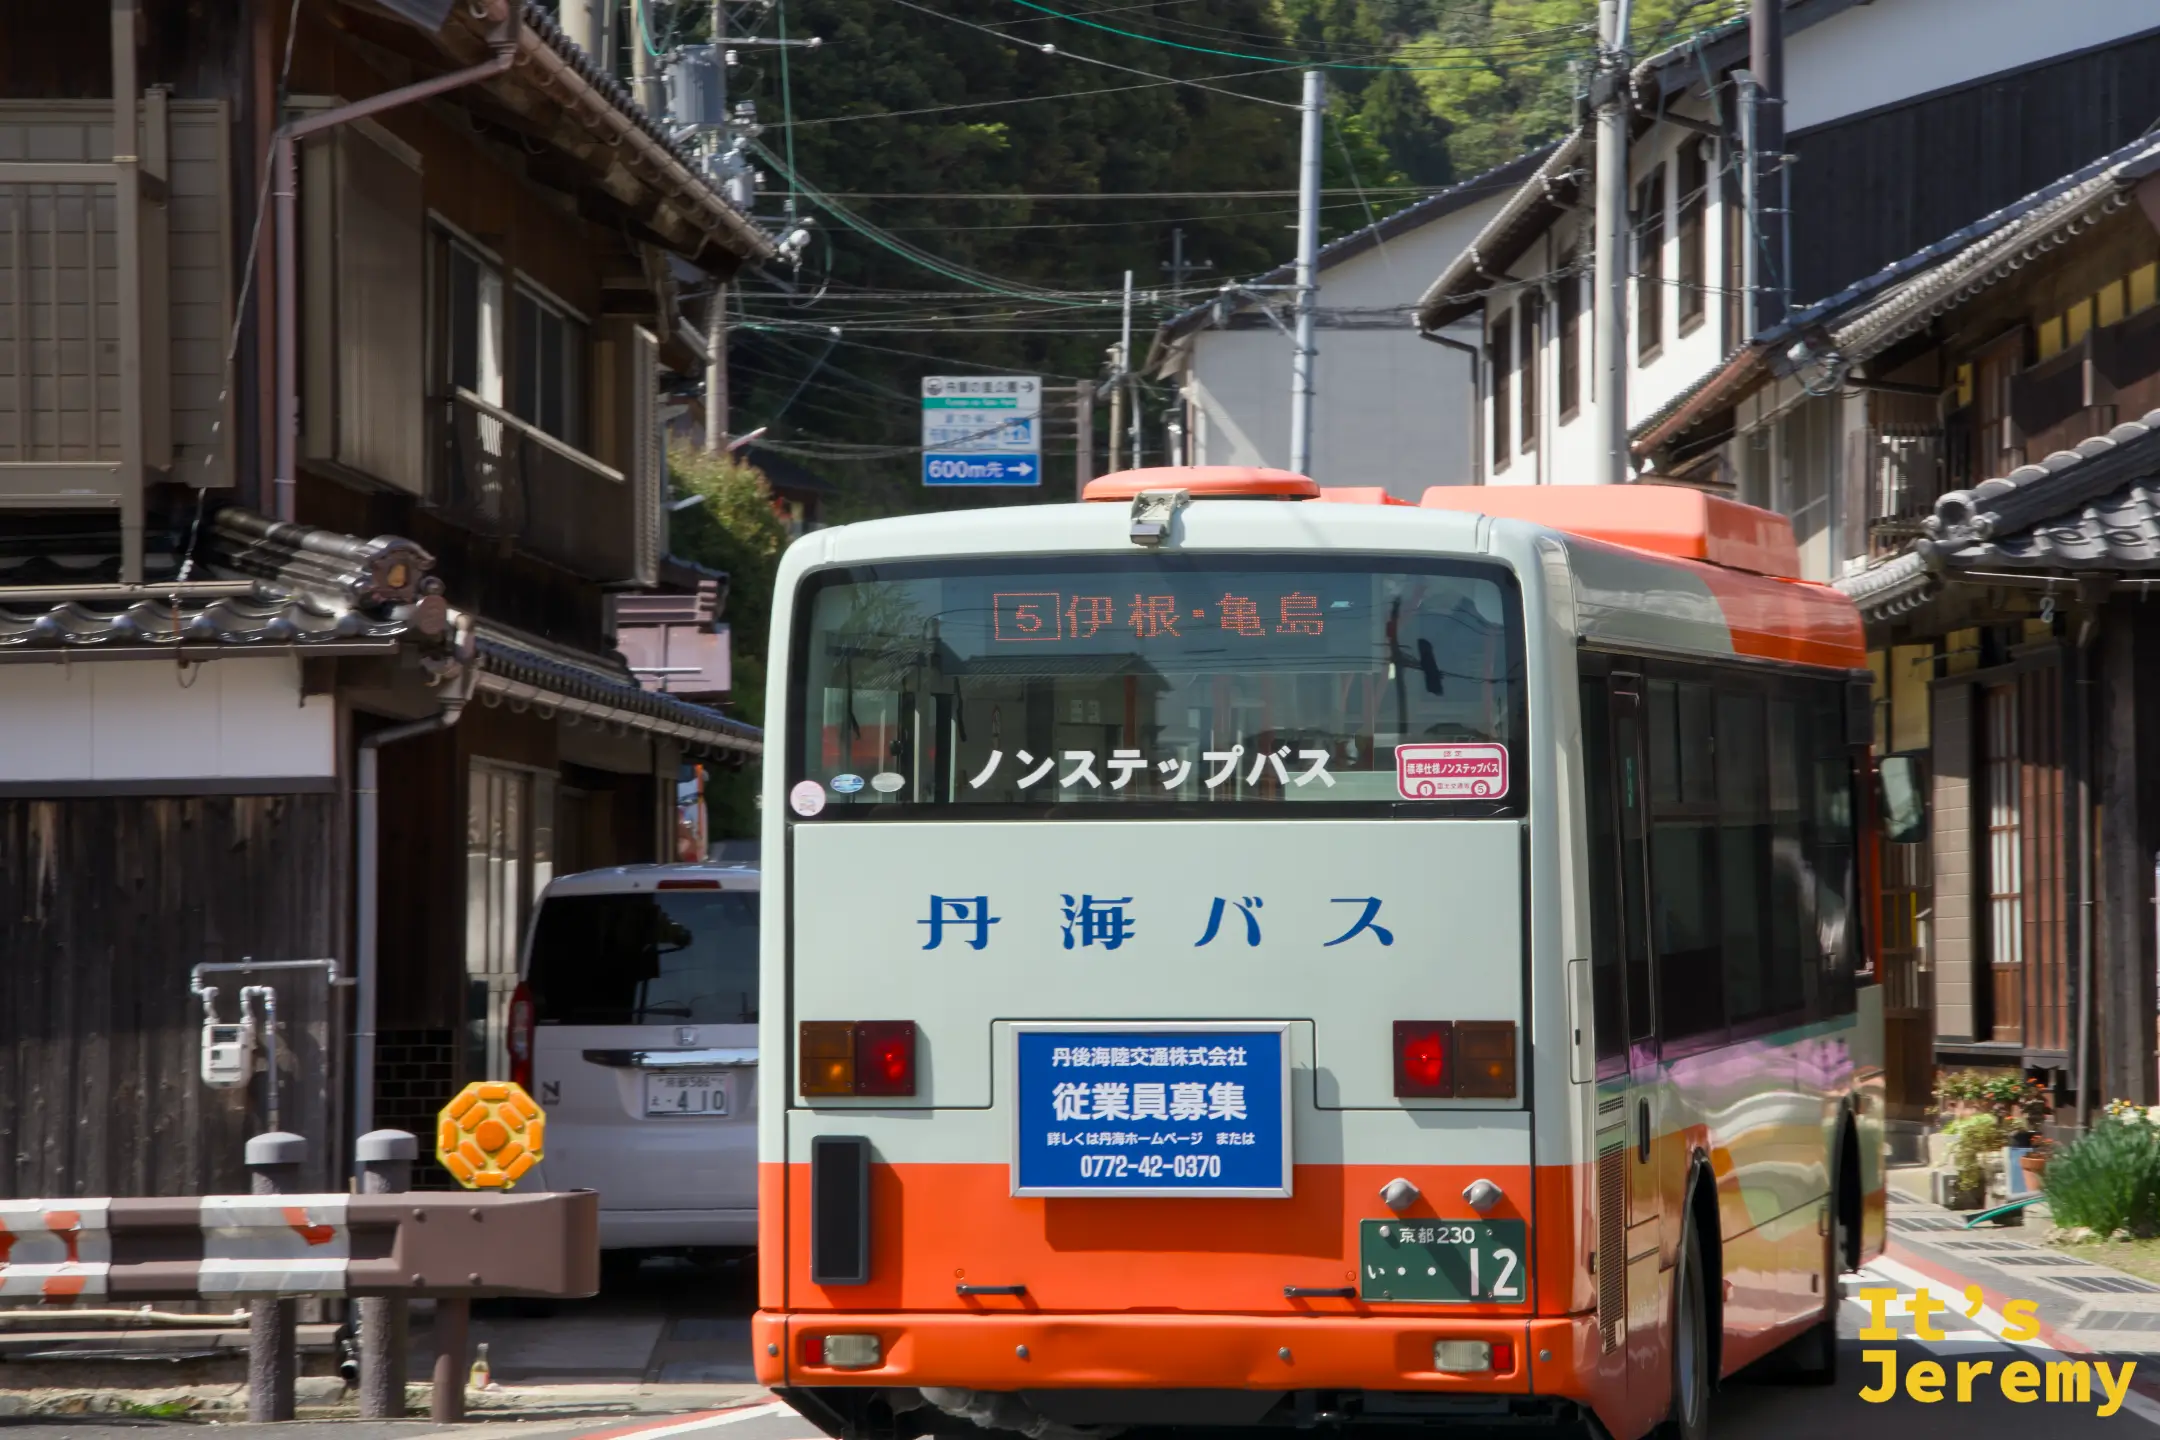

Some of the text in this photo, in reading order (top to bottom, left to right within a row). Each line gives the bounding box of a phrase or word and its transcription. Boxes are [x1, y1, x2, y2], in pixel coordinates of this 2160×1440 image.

[1015, 592, 1323, 637] 5 伊根・亀島
[969, 744, 1337, 790] ノンステップバス
[1406, 763, 1499, 774] 標準仕様ノンステップバス
[1477, 785, 1485, 794] 5
[916, 894, 1395, 951] 丹海バス
[1052, 1046, 1247, 1068] 丹後海陸交通株式会社
[1052, 1082, 1248, 1121] 従業員募集
[1047, 1132, 1256, 1146] 詳しくは丹海ホームページ または
[1080, 1155, 1221, 1178] 0772-42-0370
[1470, 1247, 1518, 1297] 12
